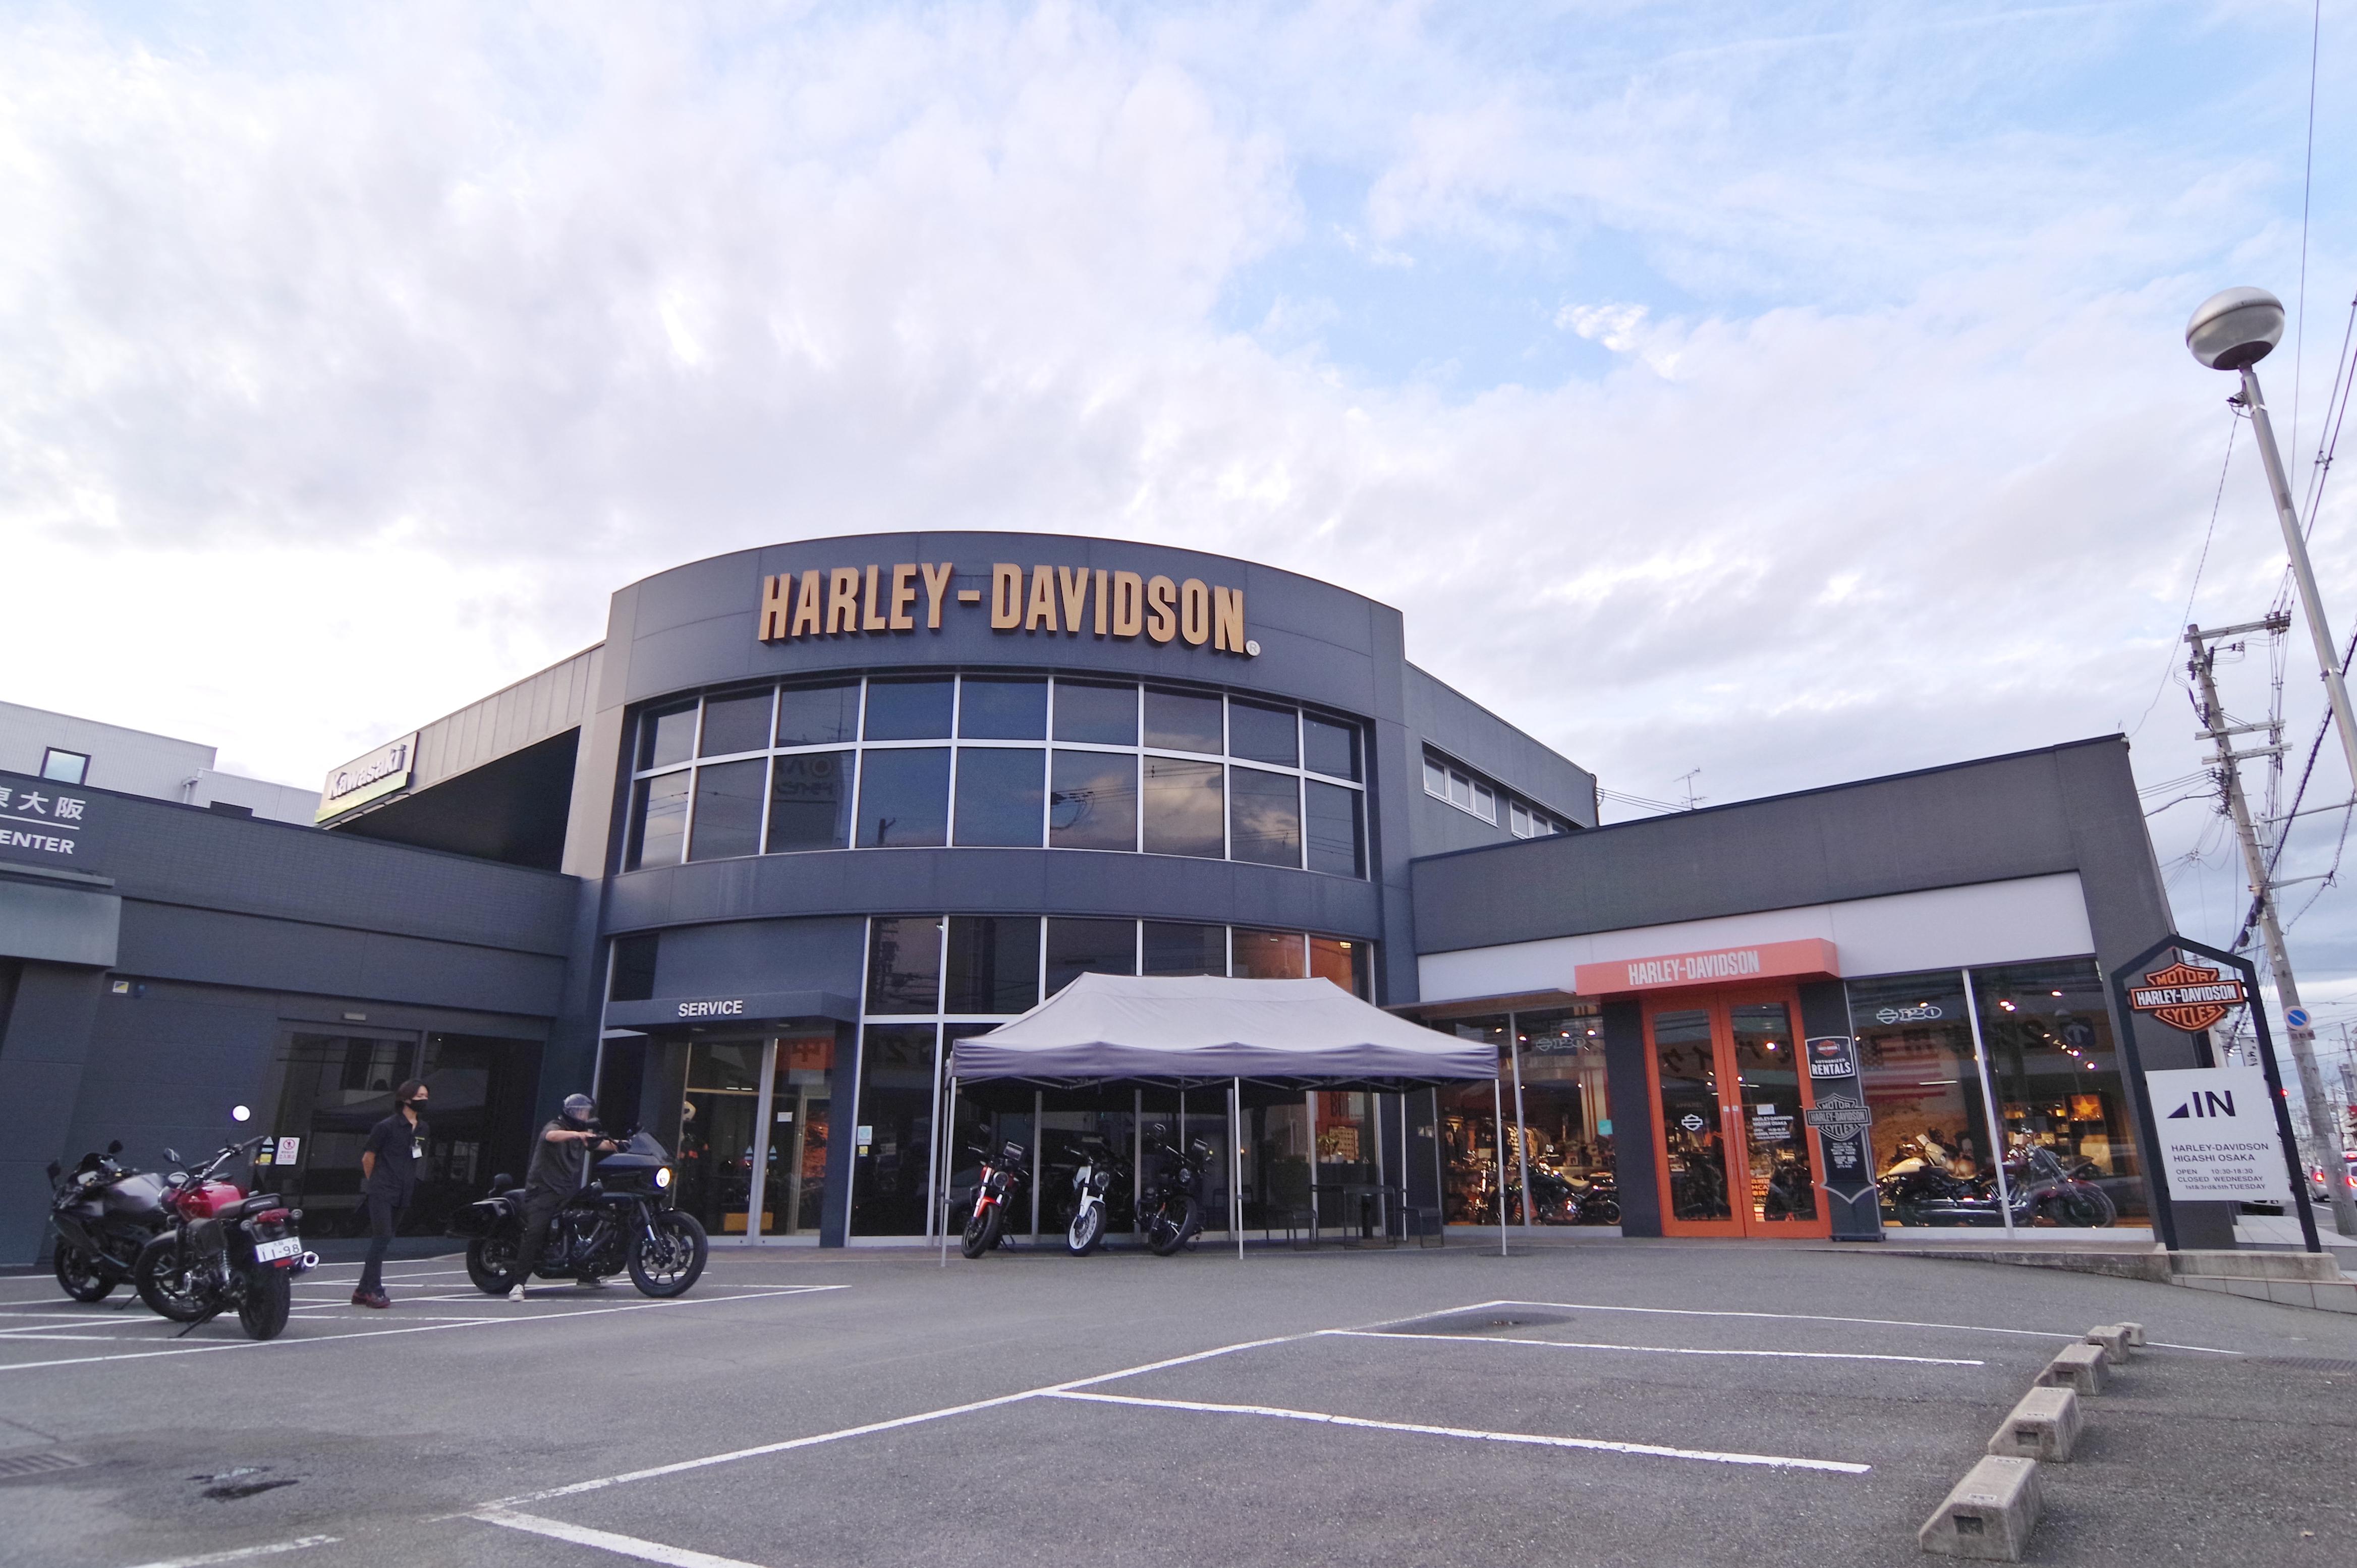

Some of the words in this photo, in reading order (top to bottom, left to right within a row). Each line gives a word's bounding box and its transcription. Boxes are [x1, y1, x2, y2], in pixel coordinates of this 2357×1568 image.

[758, 562, 1244, 654] HARLEY-DAVIDSON
[328, 744, 407, 800] Kawasaki
[1628, 950, 1760, 986] HARLEY-DAVIDSON
[2156, 967, 2209, 985] MOTOR
[2136, 985, 2237, 1006] HARLEY-DAVIDSON
[678, 1000, 743, 1017] SERVICE
[2163, 1005, 2215, 1027] CYCLES
[1811, 1062, 1851, 1075] RENTALS
[1822, 1099, 1851, 1110] MOTOR
[2192, 1090, 2236, 1118] IN
[1810, 1111, 1865, 1123] HARLEY-DAVIDSON
[1825, 1124, 1855, 1136] CYCLES
[2171, 1143, 2269, 1152] HARLEY-DAVIDSON
[262, 1244, 300, 1260] 11-98
